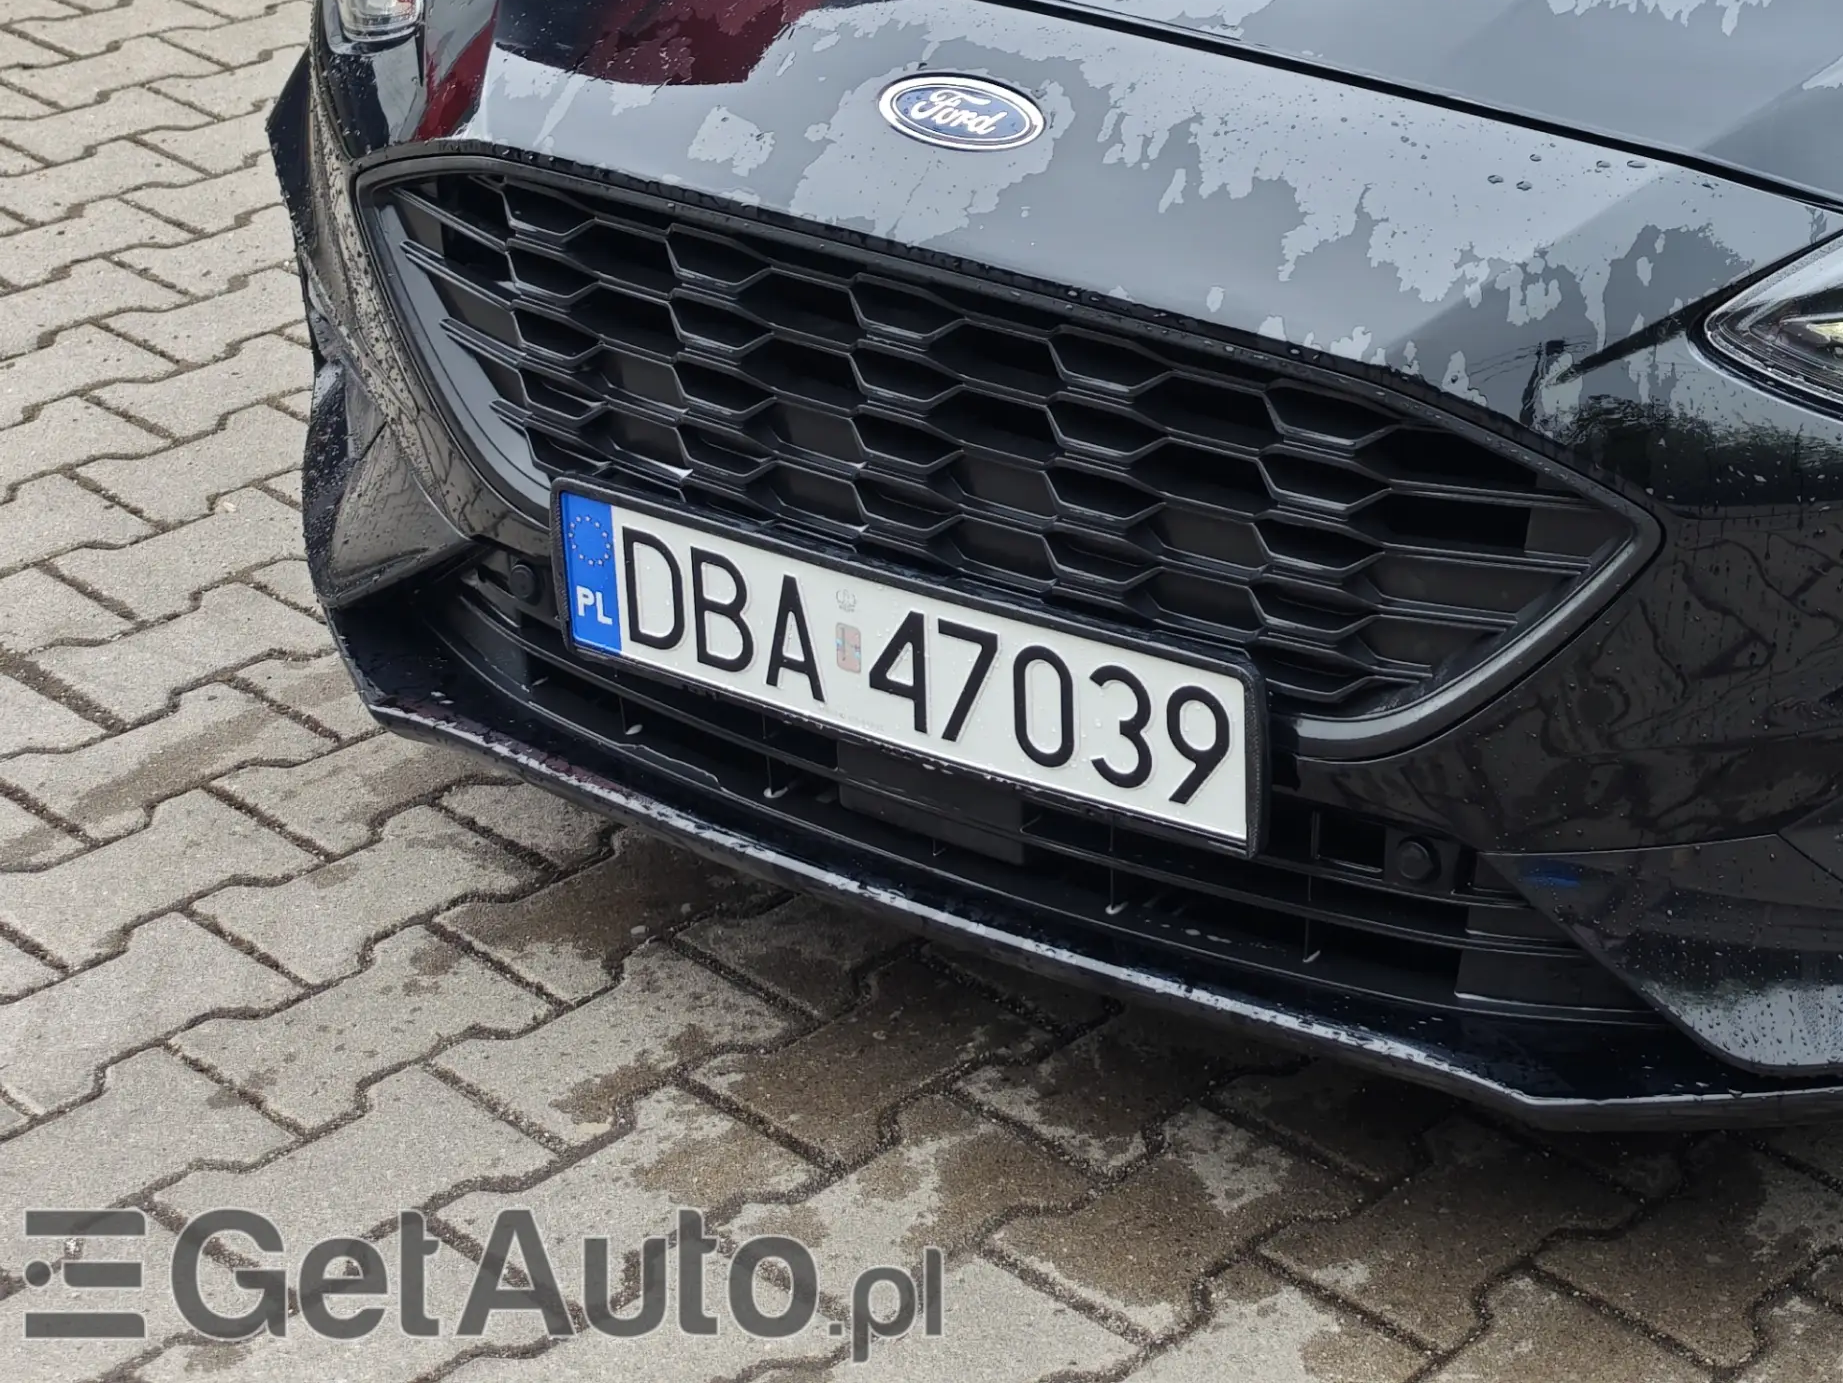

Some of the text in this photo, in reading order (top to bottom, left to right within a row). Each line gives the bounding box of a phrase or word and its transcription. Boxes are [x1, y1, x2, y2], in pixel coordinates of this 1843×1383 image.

[910, 89, 1008, 136] Ford
[576, 585, 613, 625] PL
[622, 526, 1231, 805] DBA 47039
